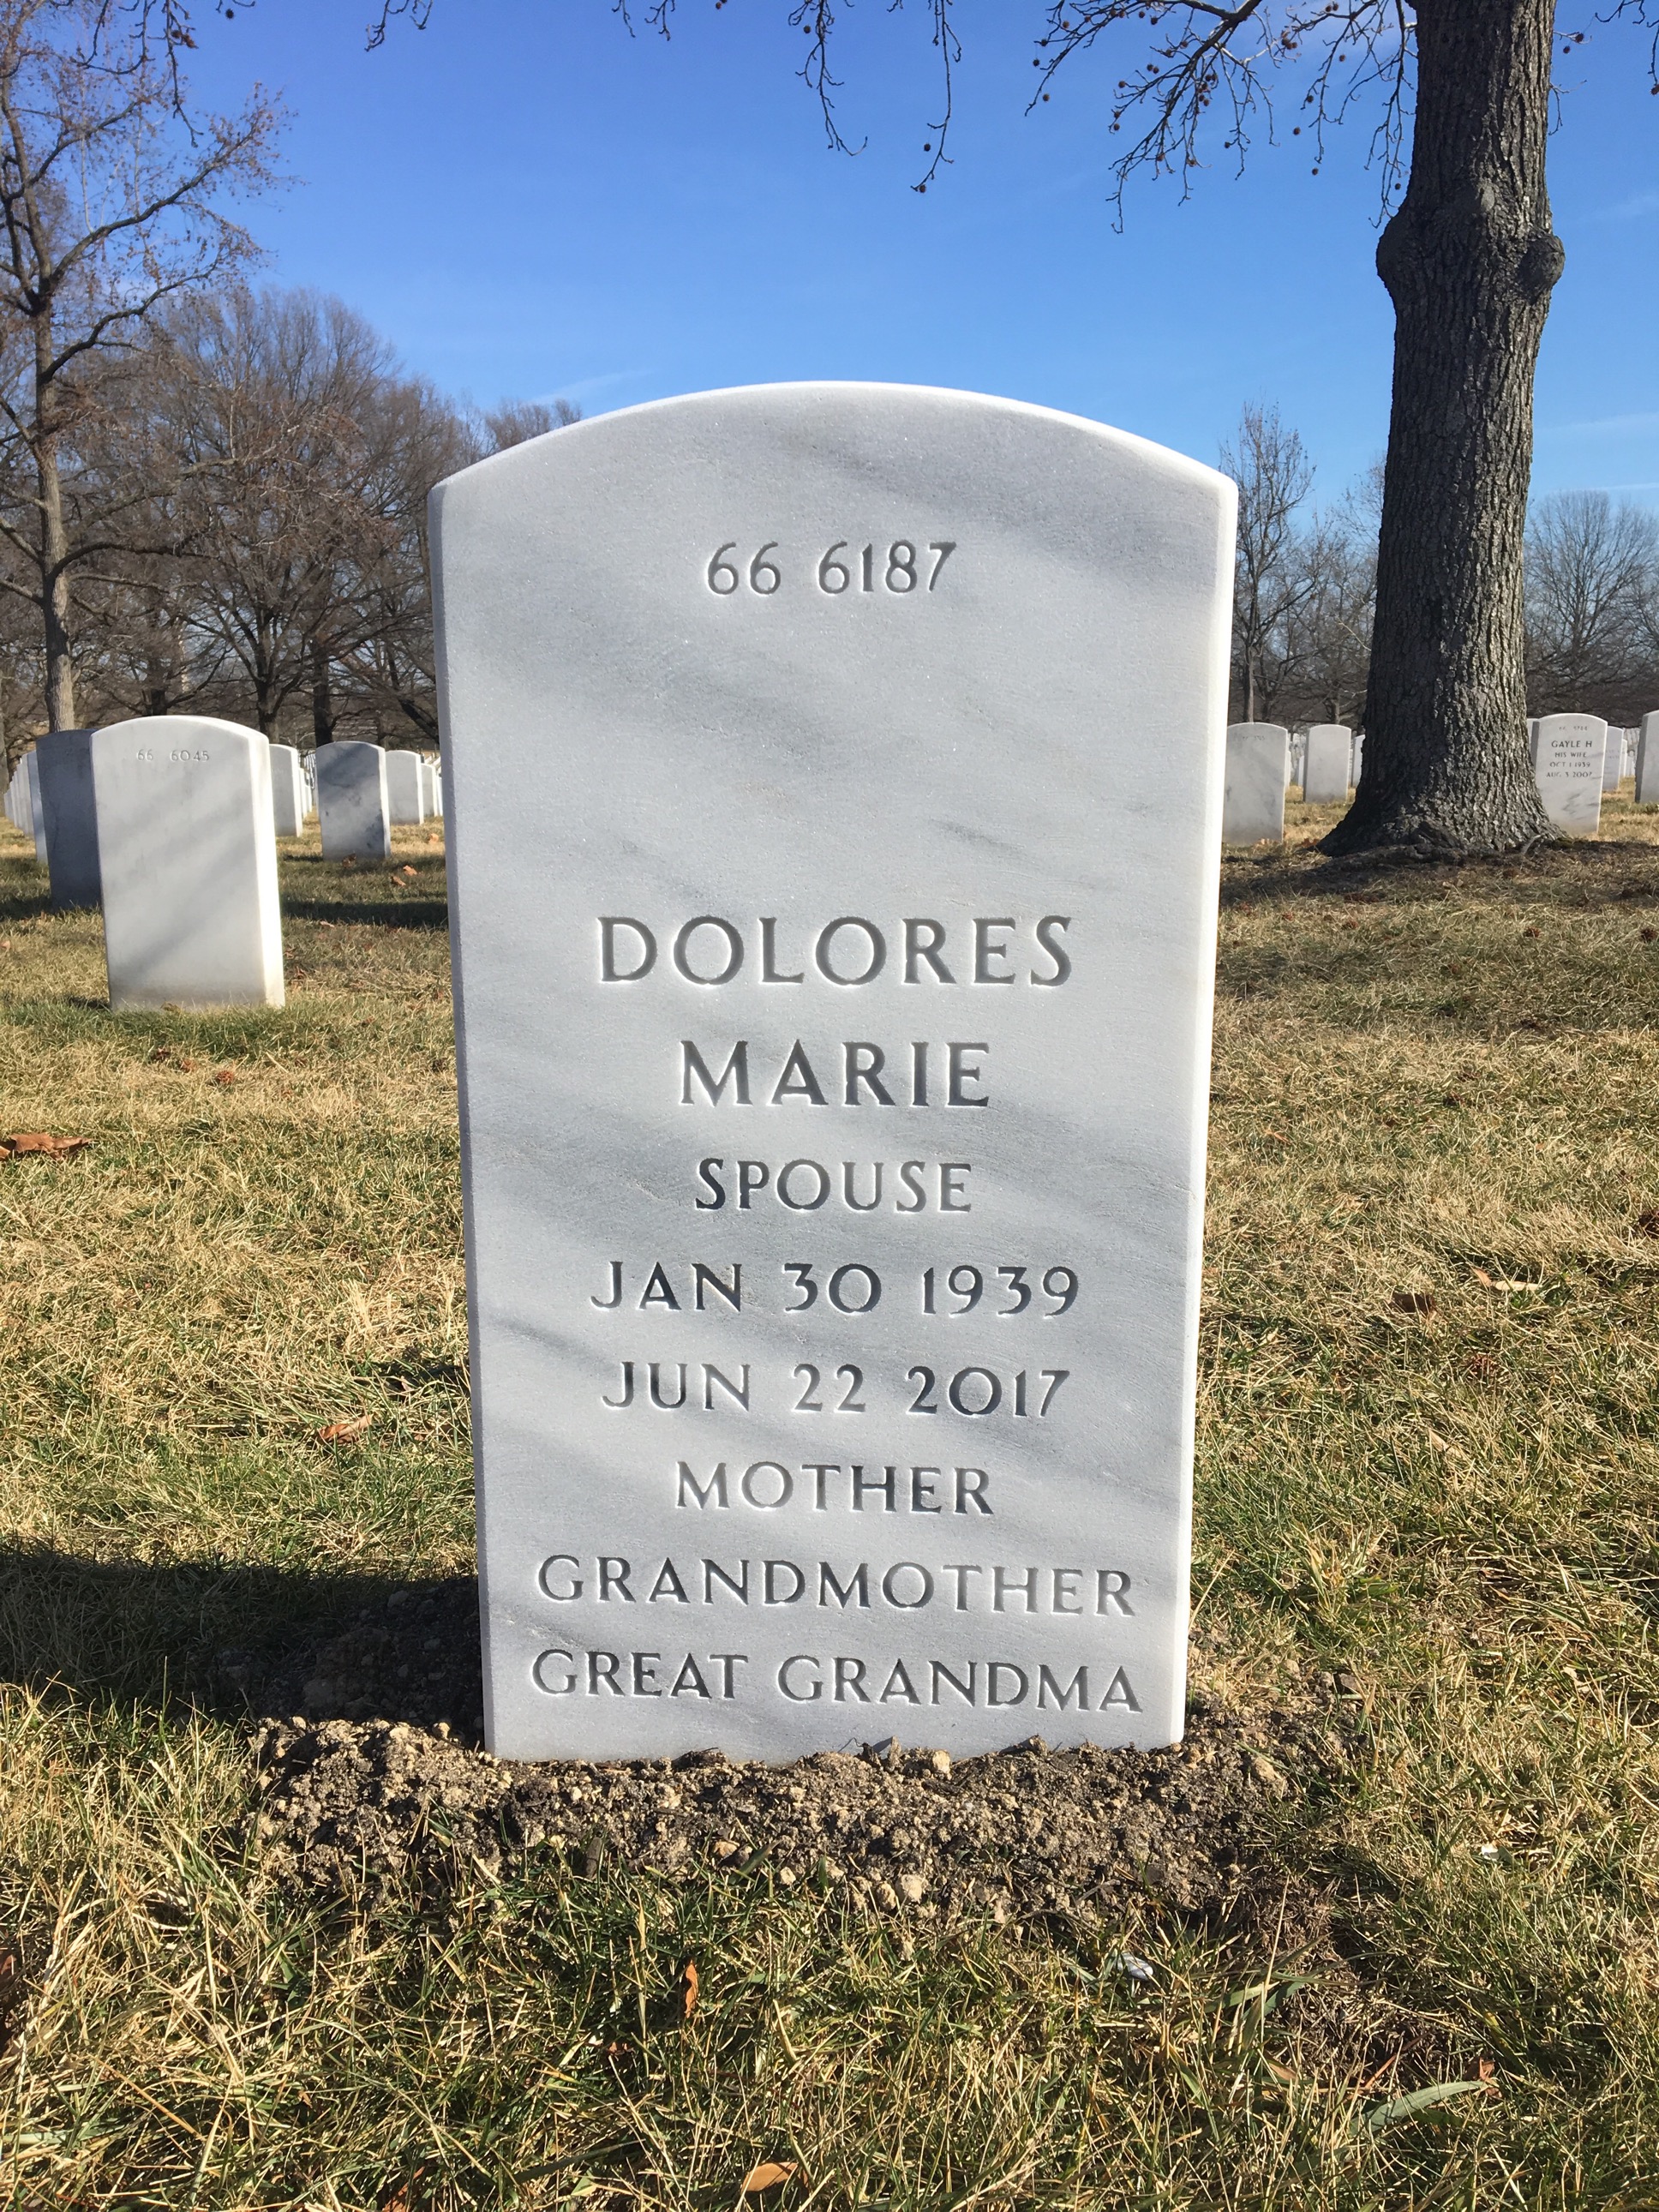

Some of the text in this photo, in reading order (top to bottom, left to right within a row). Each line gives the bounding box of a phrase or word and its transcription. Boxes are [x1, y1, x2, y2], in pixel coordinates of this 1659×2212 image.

[707, 539, 958, 596] 66 6187
[136, 748, 210, 762] 66 6045
[1551, 740, 1581, 748] GAYLE
[596, 914, 1074, 987] DOLORES
[679, 1038, 991, 1108] MARIE
[695, 1157, 973, 1214] SPOUSE
[590, 1260, 1081, 1317] JAN 30 1939
[602, 1361, 1071, 1418] JUN 22 2017
[676, 1460, 996, 1516] MOTHER
[537, 1554, 1136, 1618] GRANDMOTHER
[531, 1647, 1145, 1713] GREAT GRANDMA
